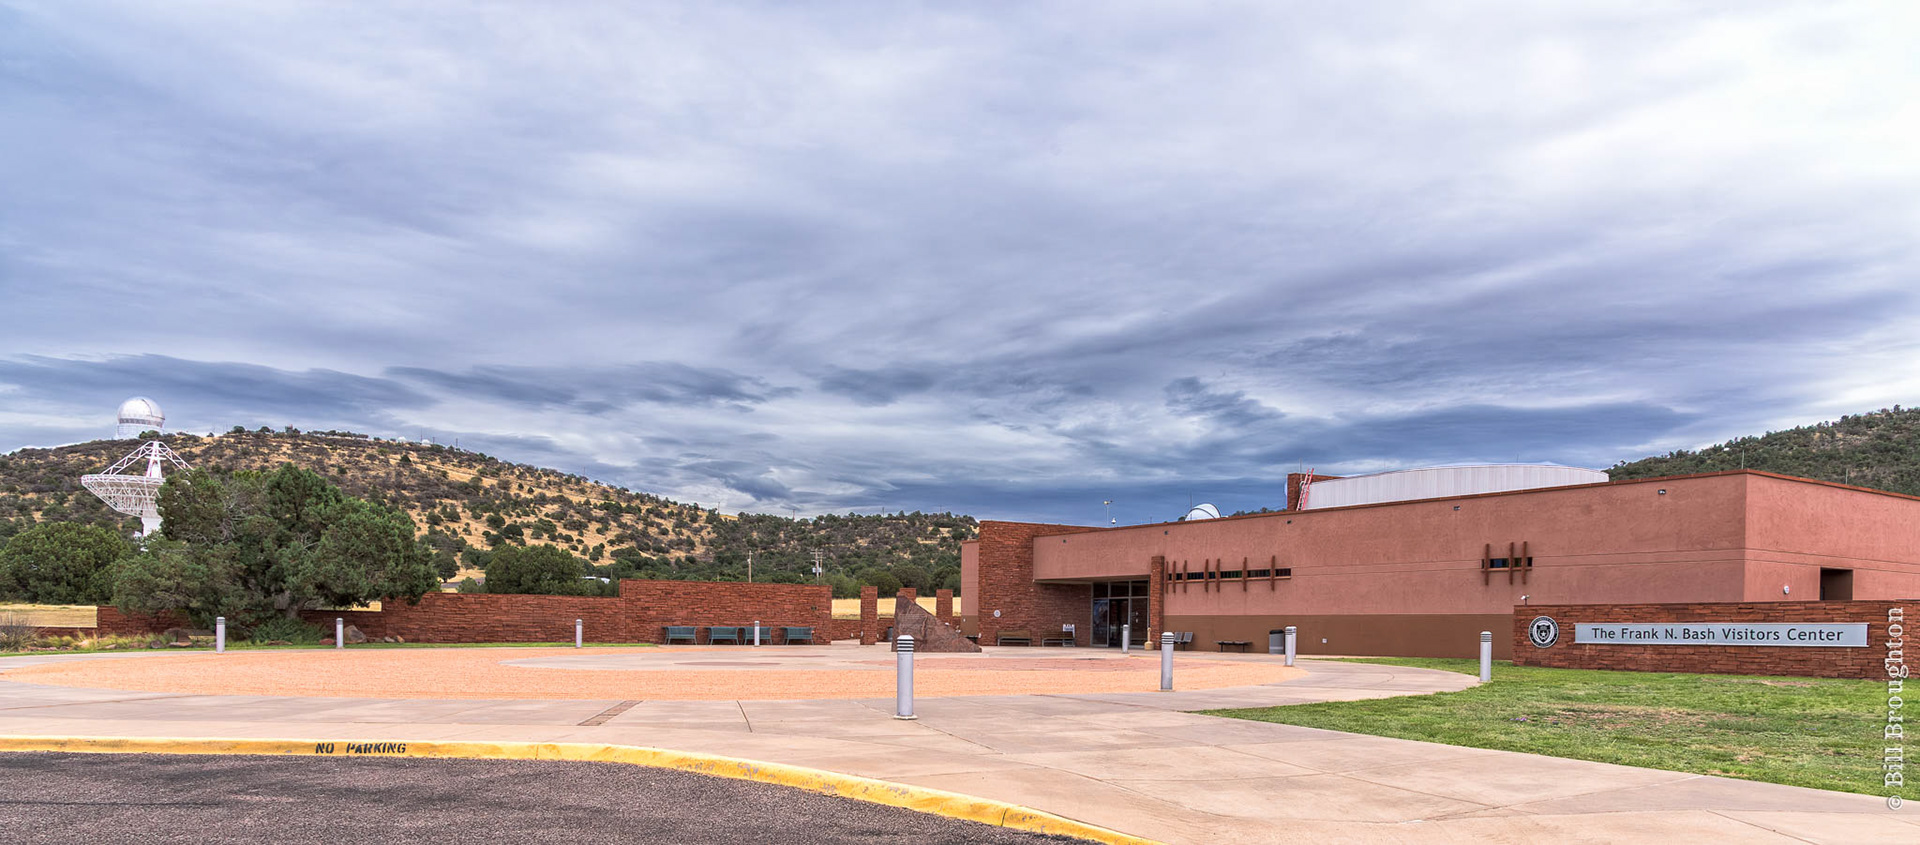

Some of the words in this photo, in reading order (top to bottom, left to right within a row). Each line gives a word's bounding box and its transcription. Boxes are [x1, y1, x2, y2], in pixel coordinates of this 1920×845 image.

[1591, 627, 1616, 639] The
[1621, 627, 1659, 640] Frank
[1664, 628, 1678, 640] N.
[1682, 627, 1716, 640] Bash
[1721, 627, 1780, 641] Visitors
[1786, 627, 1844, 641] Center
[315, 742, 335, 754] NO
[346, 742, 407, 754] PARKING
